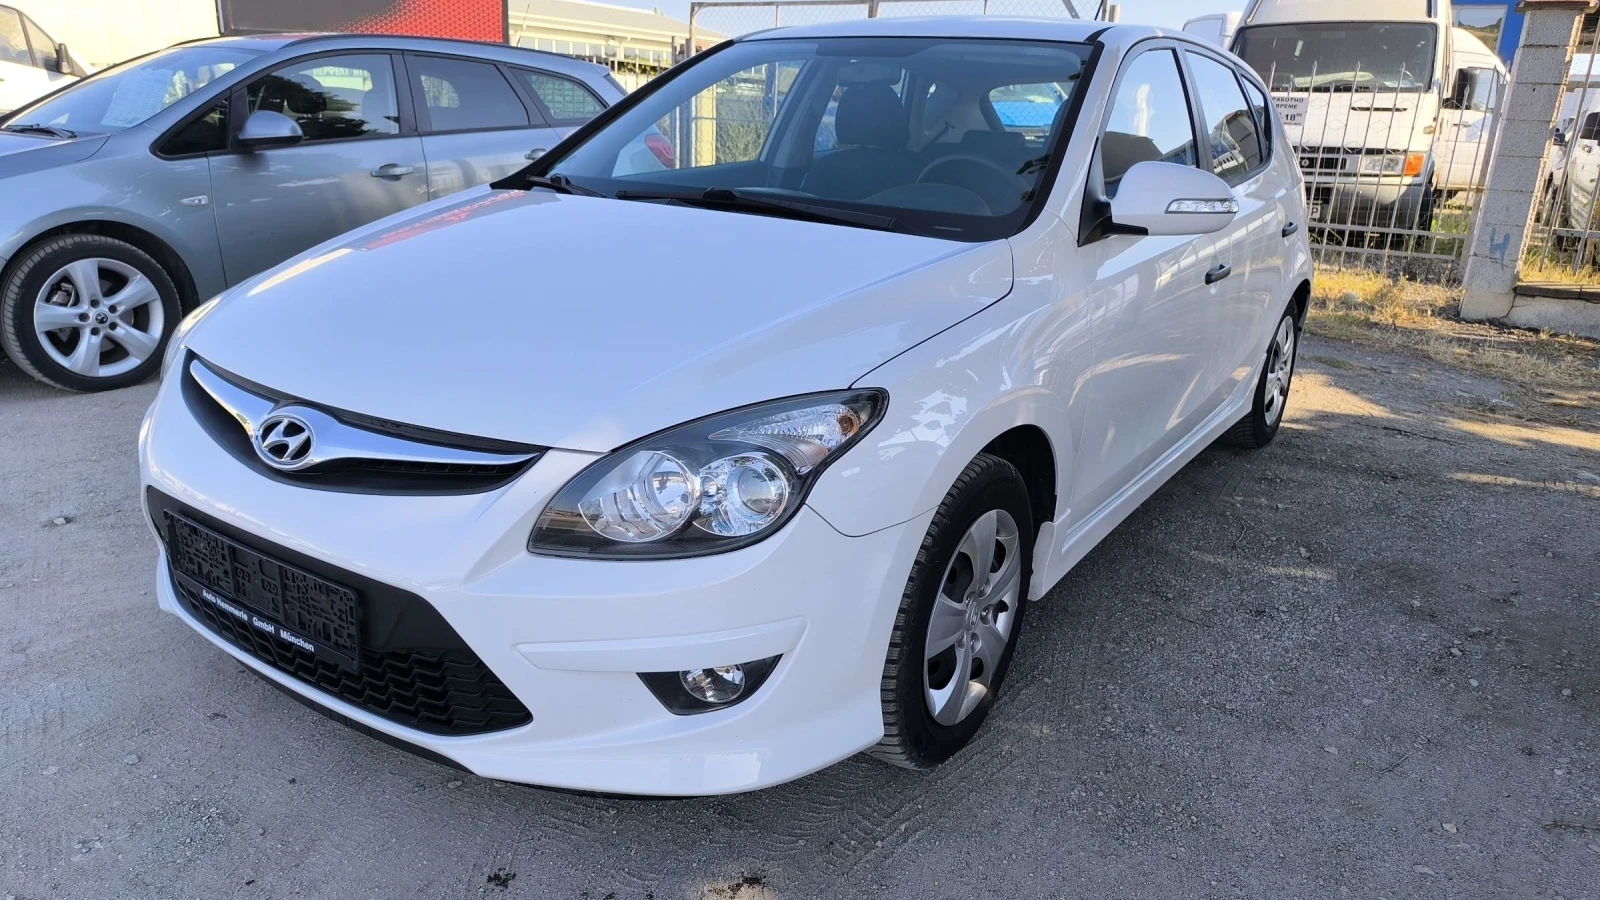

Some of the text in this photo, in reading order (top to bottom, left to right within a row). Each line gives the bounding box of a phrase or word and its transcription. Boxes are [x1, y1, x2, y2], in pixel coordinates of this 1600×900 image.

[202, 589, 315, 652] Auto Hemmerle GmbH München
